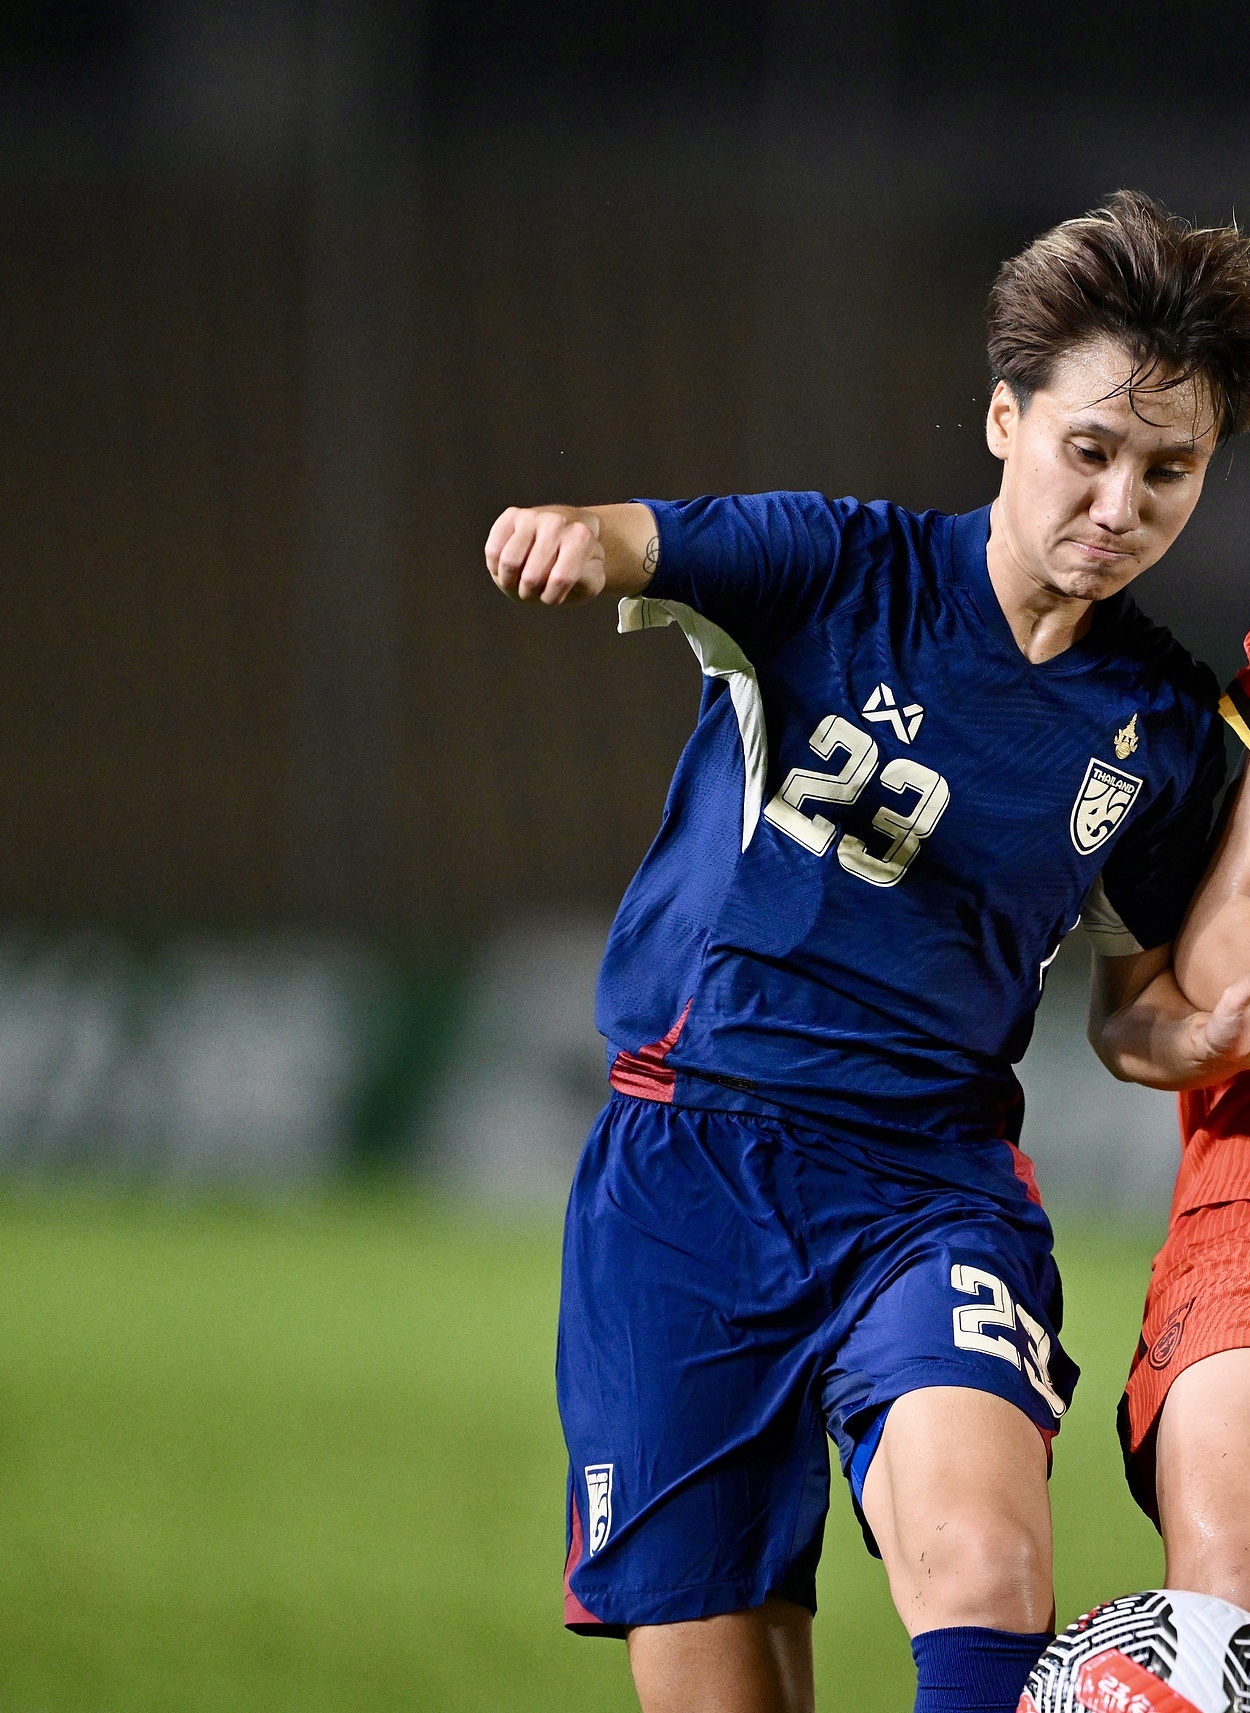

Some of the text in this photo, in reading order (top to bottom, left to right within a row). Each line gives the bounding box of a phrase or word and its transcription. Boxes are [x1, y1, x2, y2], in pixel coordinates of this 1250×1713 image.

[763, 714, 950, 888] 23
[1092, 768, 1135, 794] THAILAND
[951, 1264, 1067, 1419] 23
